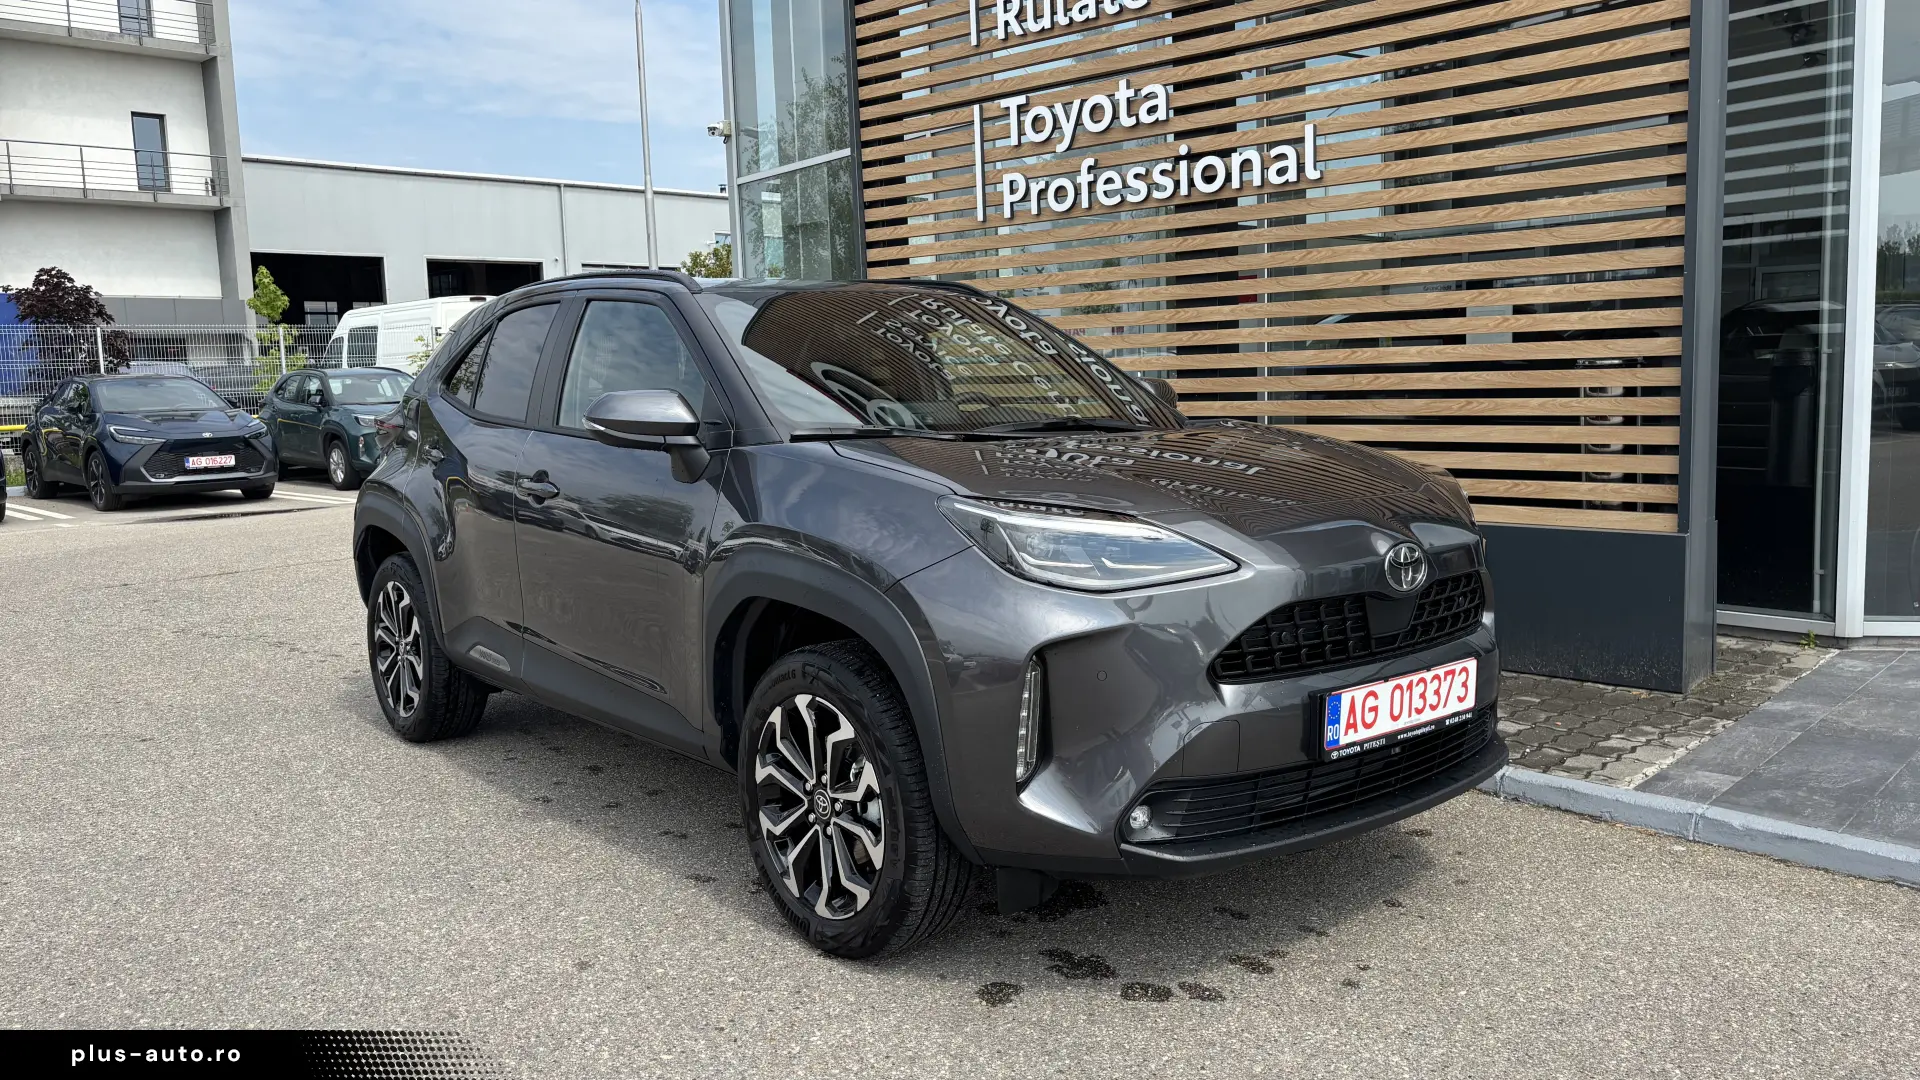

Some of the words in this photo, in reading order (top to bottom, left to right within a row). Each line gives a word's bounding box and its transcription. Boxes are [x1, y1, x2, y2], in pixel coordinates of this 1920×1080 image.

[997, 0, 1149, 40] Rula
[1001, 78, 1170, 153] Toyota
[1002, 123, 1322, 219] Professional
[191, 457, 202, 466] AG
[205, 456, 233, 465] 016227
[1343, 690, 1379, 737] AG
[1389, 665, 1470, 723] 013373
[1326, 723, 1340, 742] RO
[1338, 745, 1361, 757] TOYOTA
